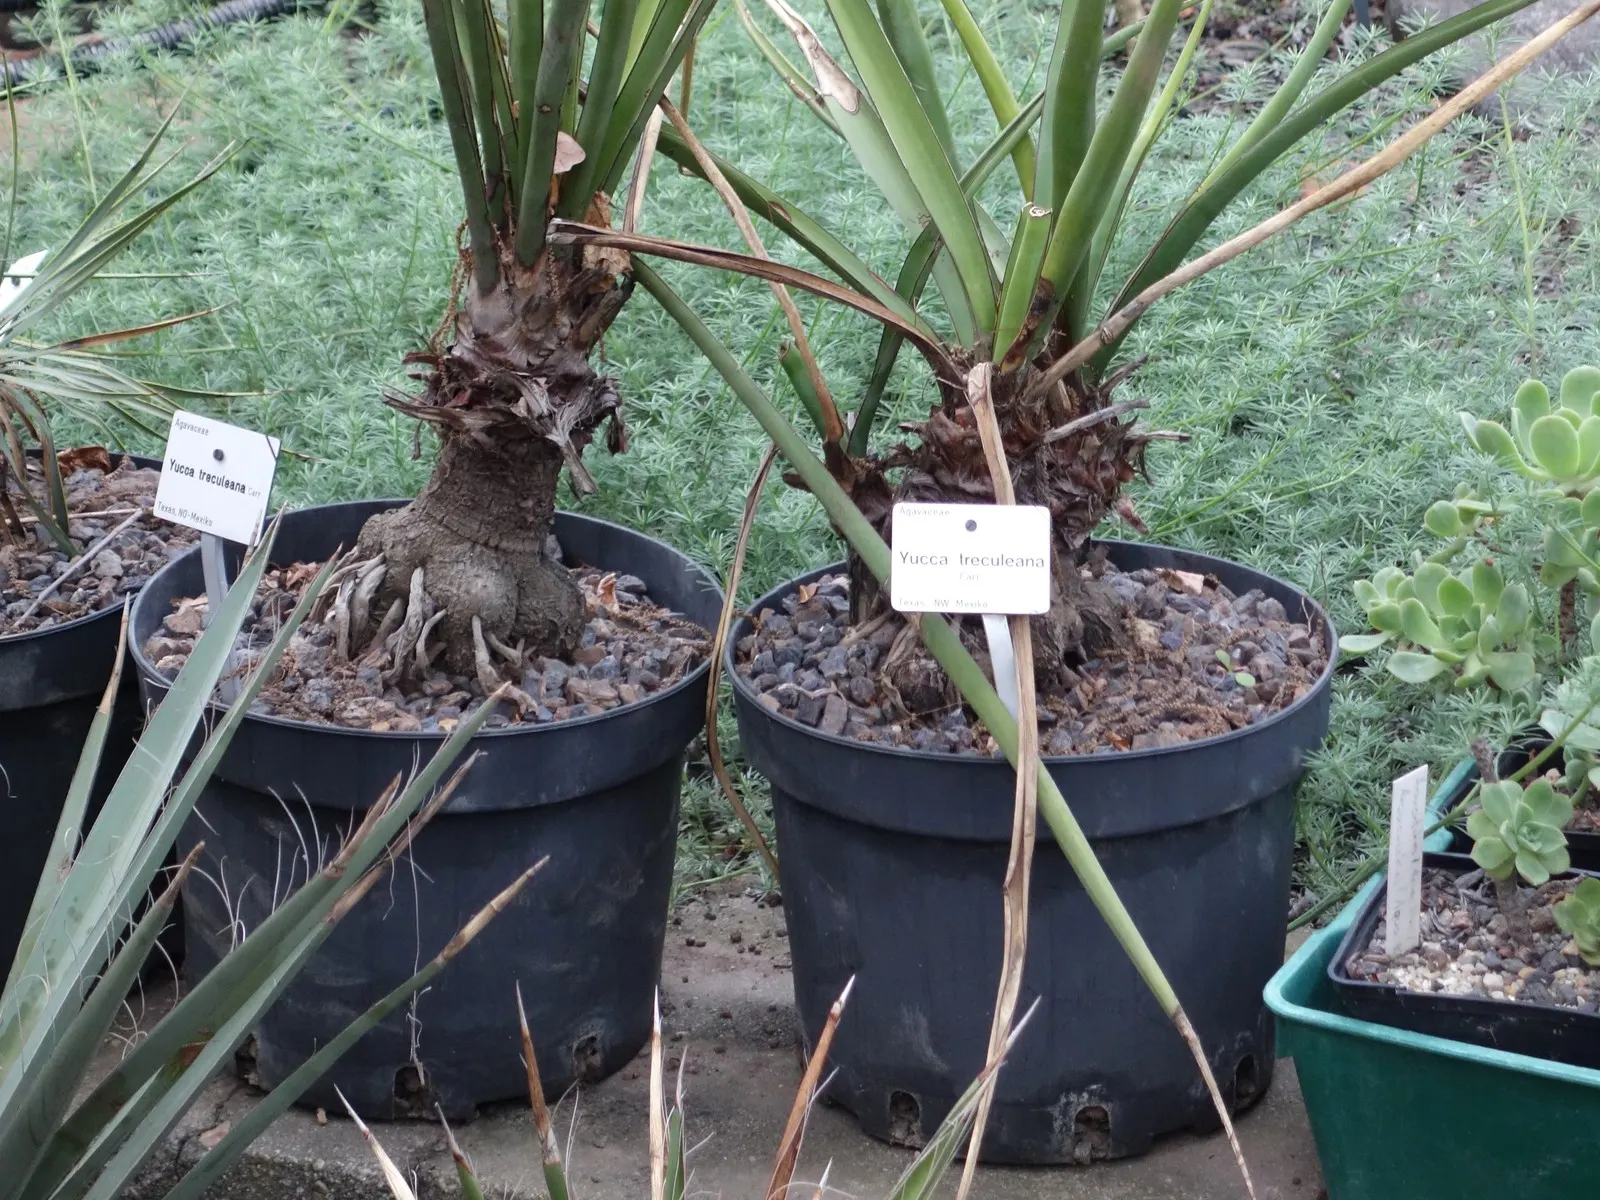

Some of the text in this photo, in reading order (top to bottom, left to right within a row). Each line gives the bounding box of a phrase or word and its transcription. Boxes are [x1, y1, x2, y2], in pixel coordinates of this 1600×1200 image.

[169, 458, 195, 478] Yucca
[199, 469, 246, 494] treculeana
[899, 551, 1045, 568] Yucca treculeana
